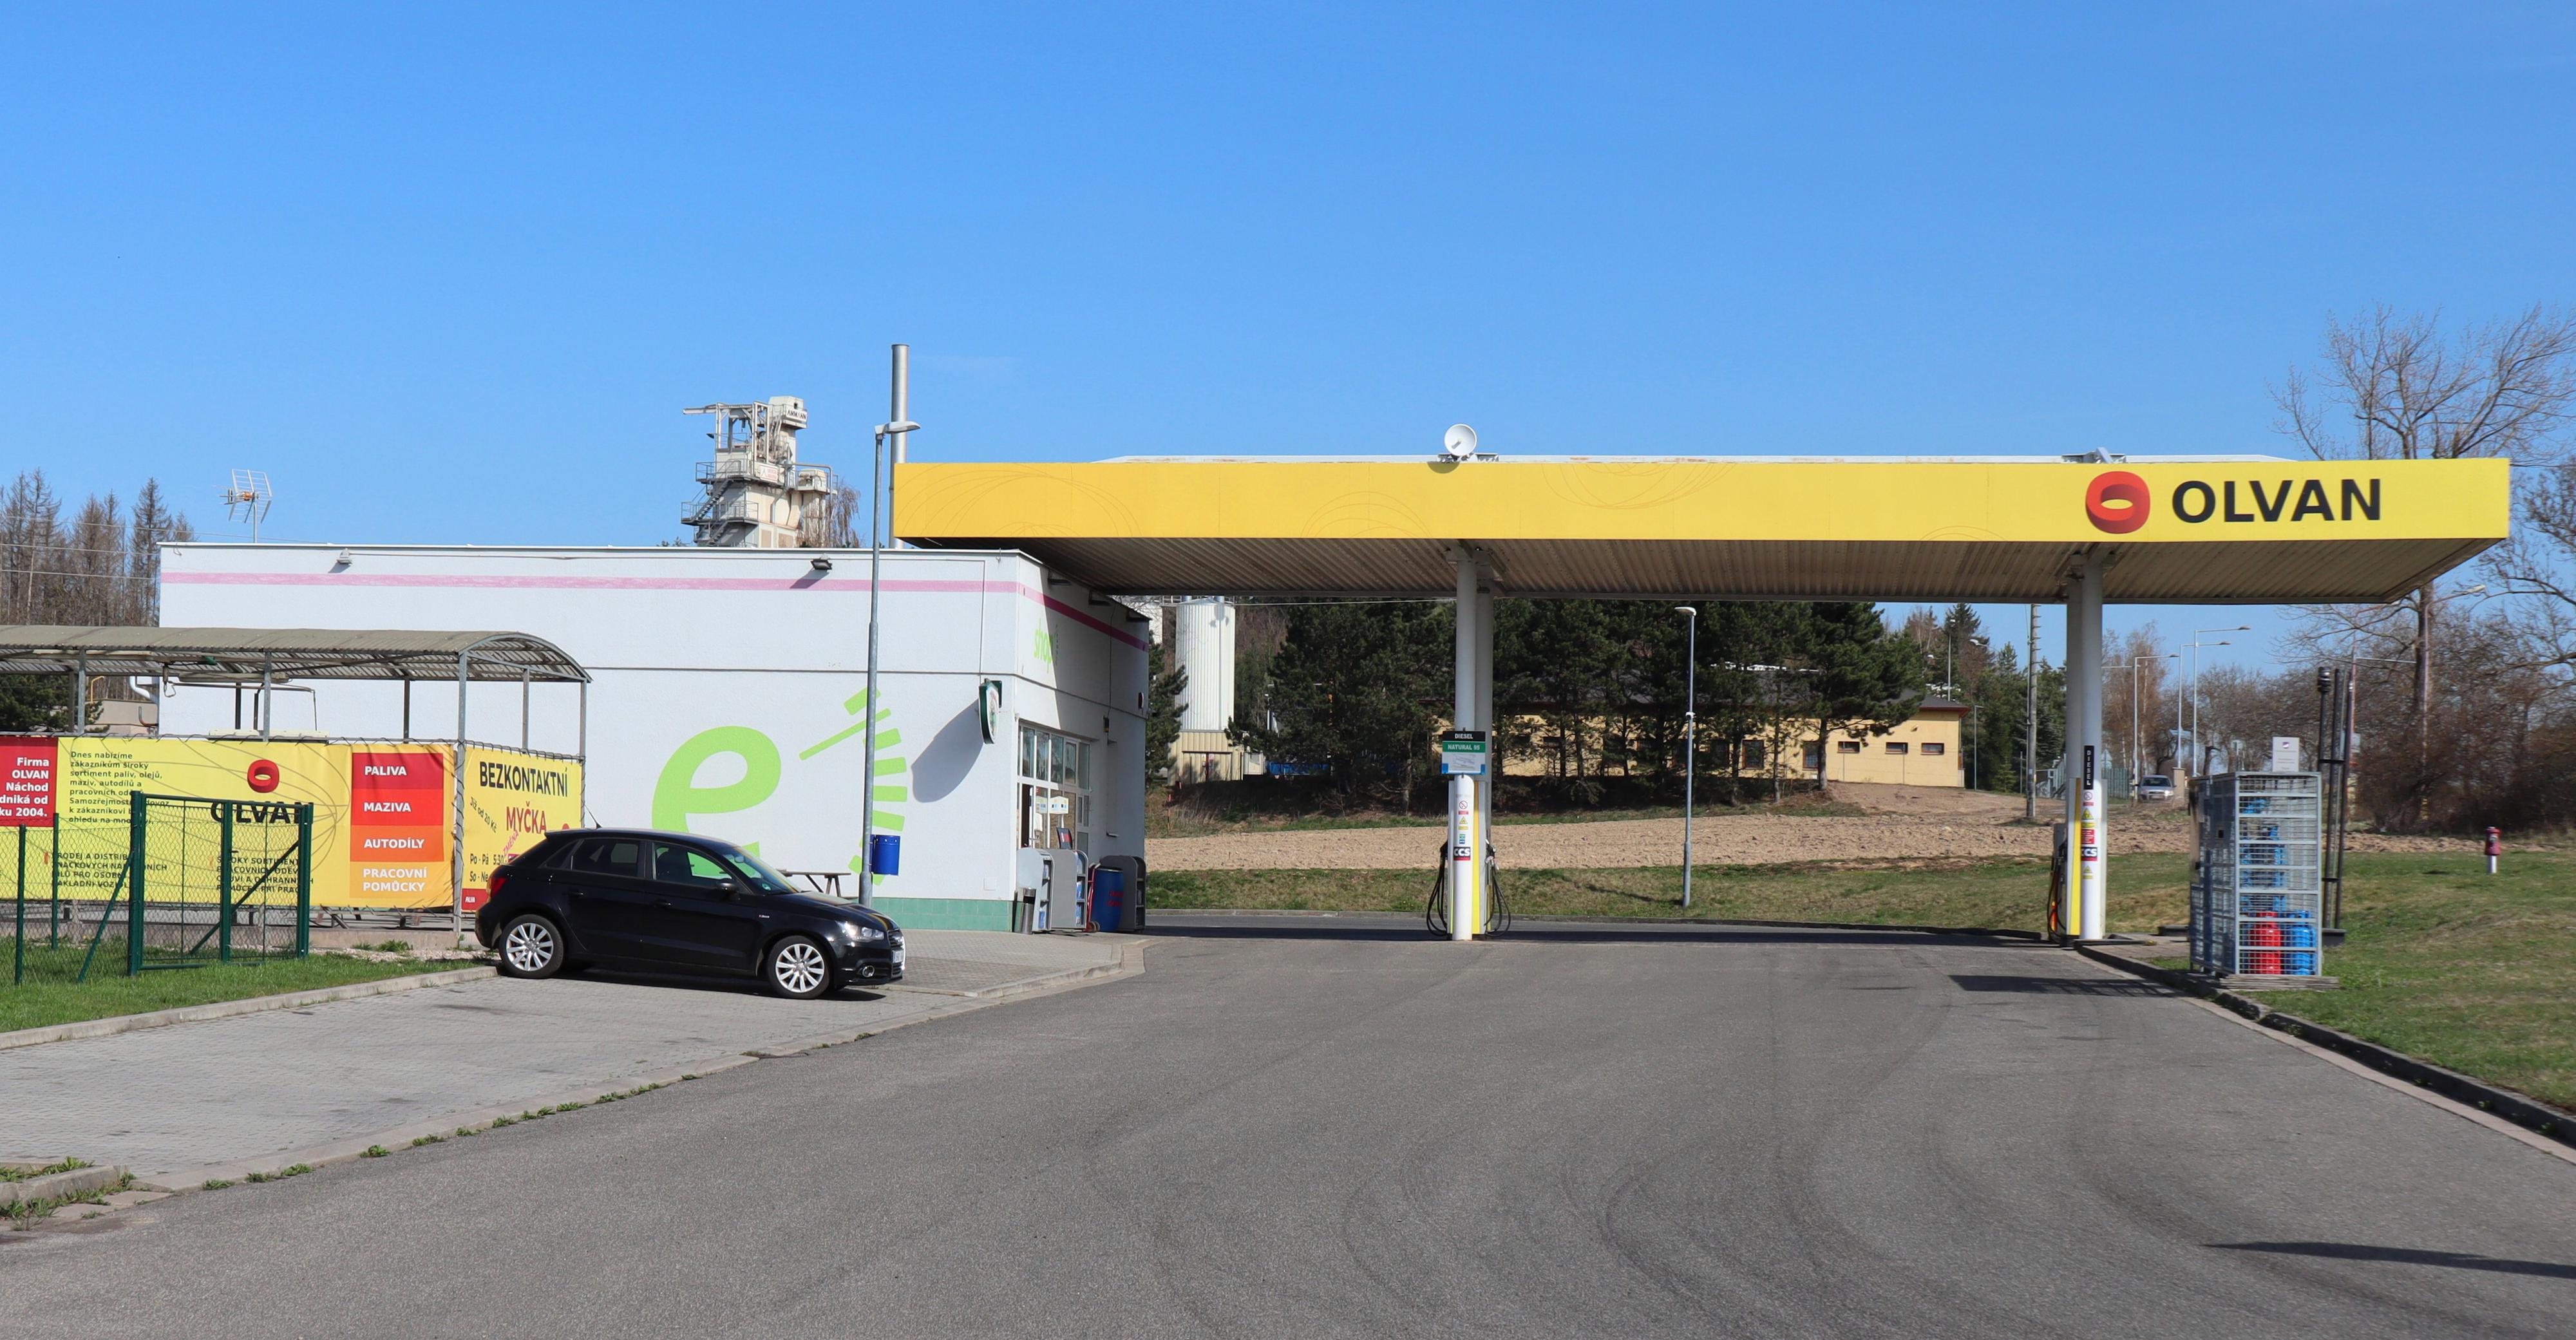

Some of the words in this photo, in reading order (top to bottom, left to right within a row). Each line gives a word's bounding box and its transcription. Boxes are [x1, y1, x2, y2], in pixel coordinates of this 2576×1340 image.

[787, 410, 806, 420] AMMANN
[2172, 478, 2381, 524] OLVAN
[17, 757, 50, 766] Firma
[123, 762, 149, 770] široký
[12, 769, 49, 779] OLVAN
[139, 771, 162, 780] olejů,
[365, 766, 407, 776] PALIVA
[480, 761, 568, 798] BEZKONTAKTNÍ
[6, 781, 49, 791] Náchod
[33, 795, 48, 804] od
[70, 797, 131, 806] Samozřejmost
[15, 807, 48, 816] 2004.
[363, 802, 412, 812] MAZIVA
[477, 807, 484, 818] od
[484, 813, 491, 826] 20
[490, 820, 498, 833] Kč
[506, 800, 547, 835] MYČKA
[363, 836, 425, 849] AUTODÍLY
[1454, 848, 1470, 856] CCS
[469, 853, 477, 865] Po
[482, 853, 489, 865] Pá
[363, 866, 428, 878] PRACOVNÍ
[469, 871, 477, 882] So
[480, 871, 489, 882] Ne
[363, 881, 426, 892] POMŮCKY
